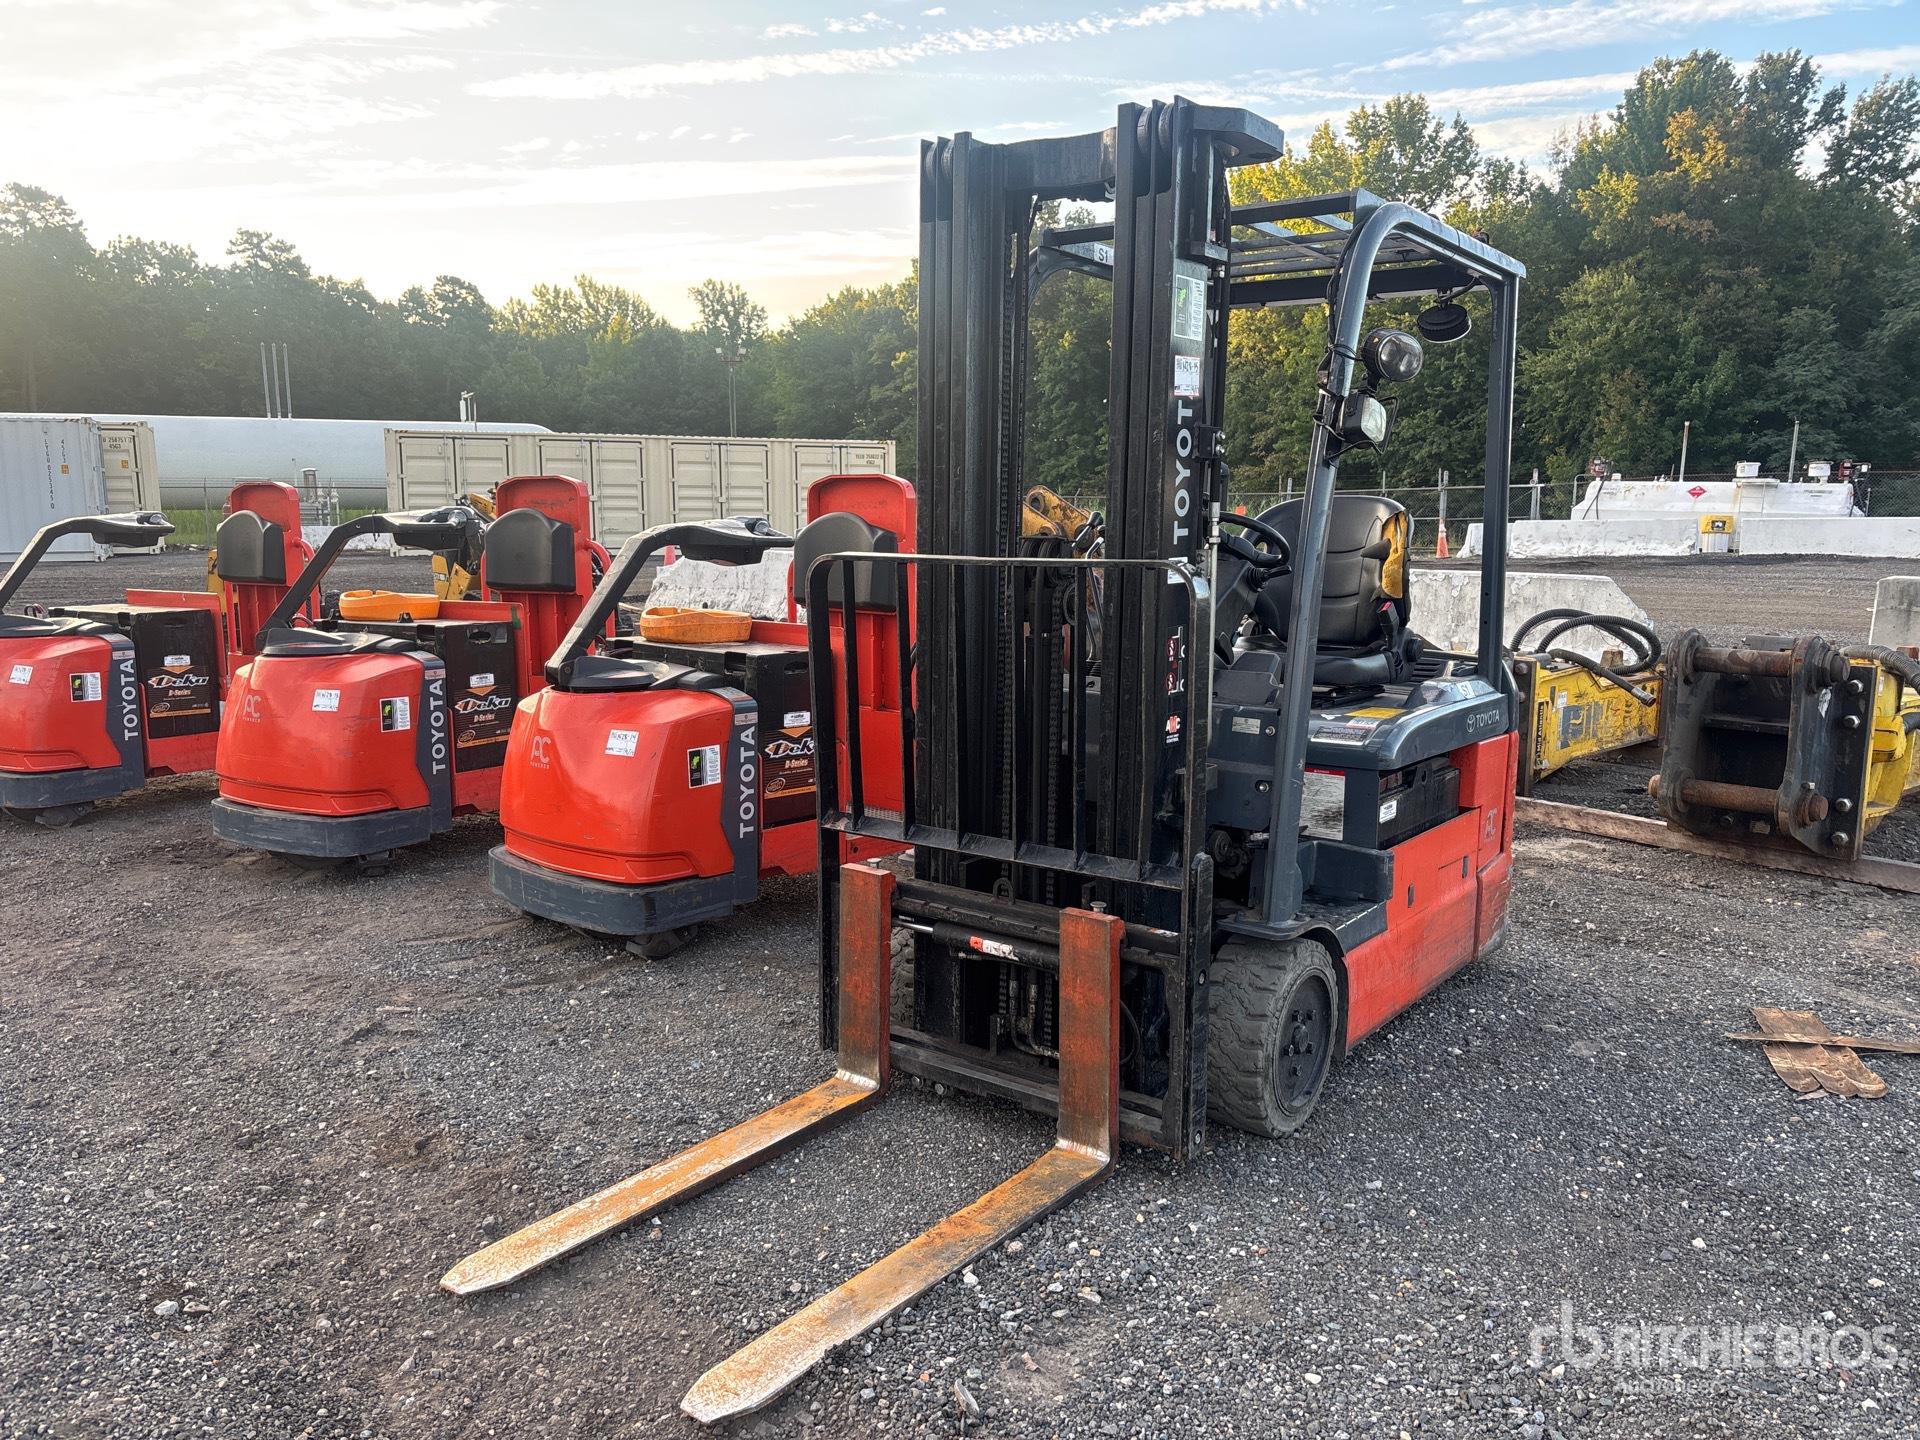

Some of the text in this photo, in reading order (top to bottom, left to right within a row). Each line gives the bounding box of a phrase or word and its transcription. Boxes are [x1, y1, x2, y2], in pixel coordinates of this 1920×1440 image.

[1098, 247, 1108, 263] S1
[1173, 399, 1193, 545] TOYOT
[148, 673, 209, 688] Deka
[119, 659, 139, 741] TOYOTA
[454, 695, 511, 714] Deka
[429, 679, 446, 775] TOYOTA
[1165, 715, 1181, 734] AMC
[1476, 708, 1500, 727] TOYOTA
[764, 737, 815, 759] Dek
[785, 757, 809, 769] D-Series
[739, 725, 756, 839] TOYOTA
